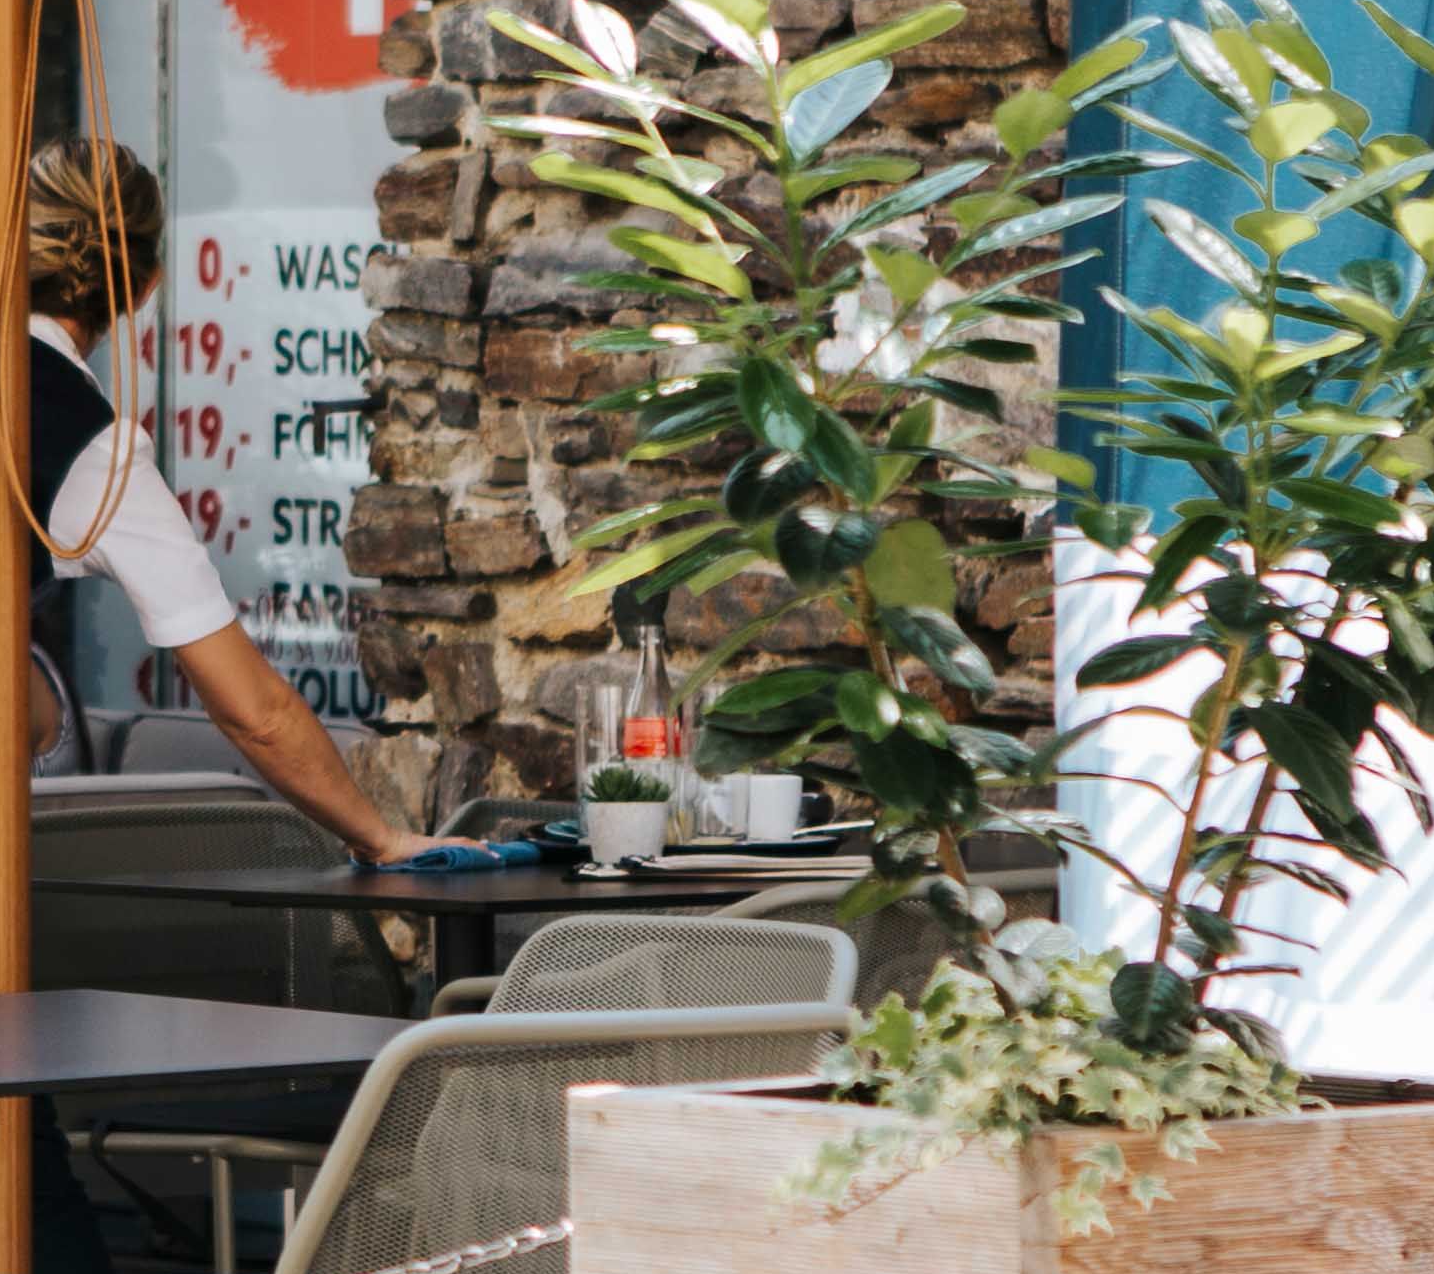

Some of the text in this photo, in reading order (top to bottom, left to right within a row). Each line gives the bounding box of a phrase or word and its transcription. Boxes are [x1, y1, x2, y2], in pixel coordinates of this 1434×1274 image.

[274, 242, 394, 292] WAS
[272, 487, 355, 548] STR
[288, 668, 387, 718] OLU
